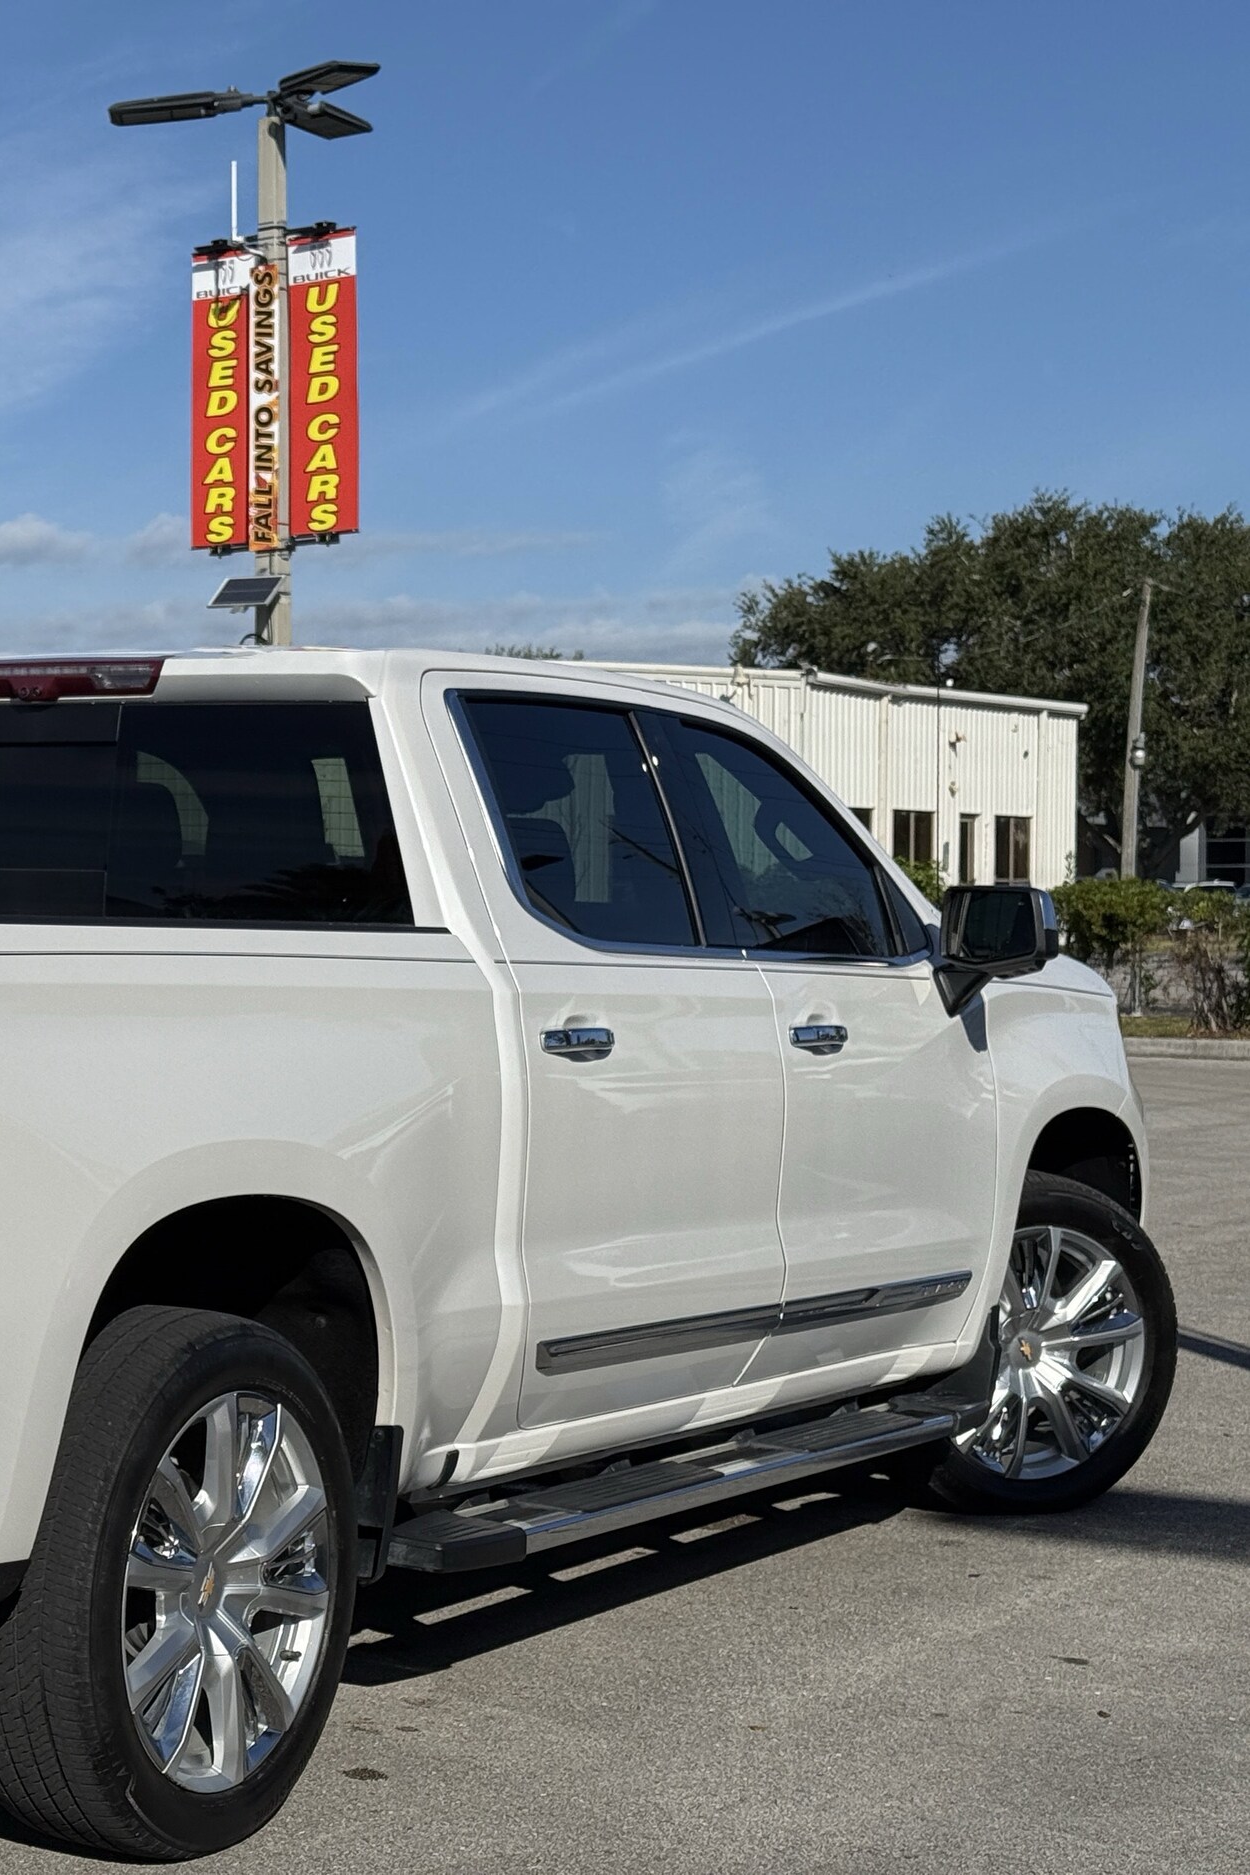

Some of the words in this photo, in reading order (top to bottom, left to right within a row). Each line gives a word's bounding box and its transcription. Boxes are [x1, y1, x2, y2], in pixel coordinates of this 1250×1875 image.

[254, 269, 275, 395] SAVINGS
[292, 267, 351, 284] BUICK
[207, 299, 241, 418] USED
[305, 283, 340, 404] USED
[203, 427, 238, 544] CARS
[254, 406, 274, 472] INTO
[304, 413, 341, 533] CARS
[254, 485, 274, 544] FALL
